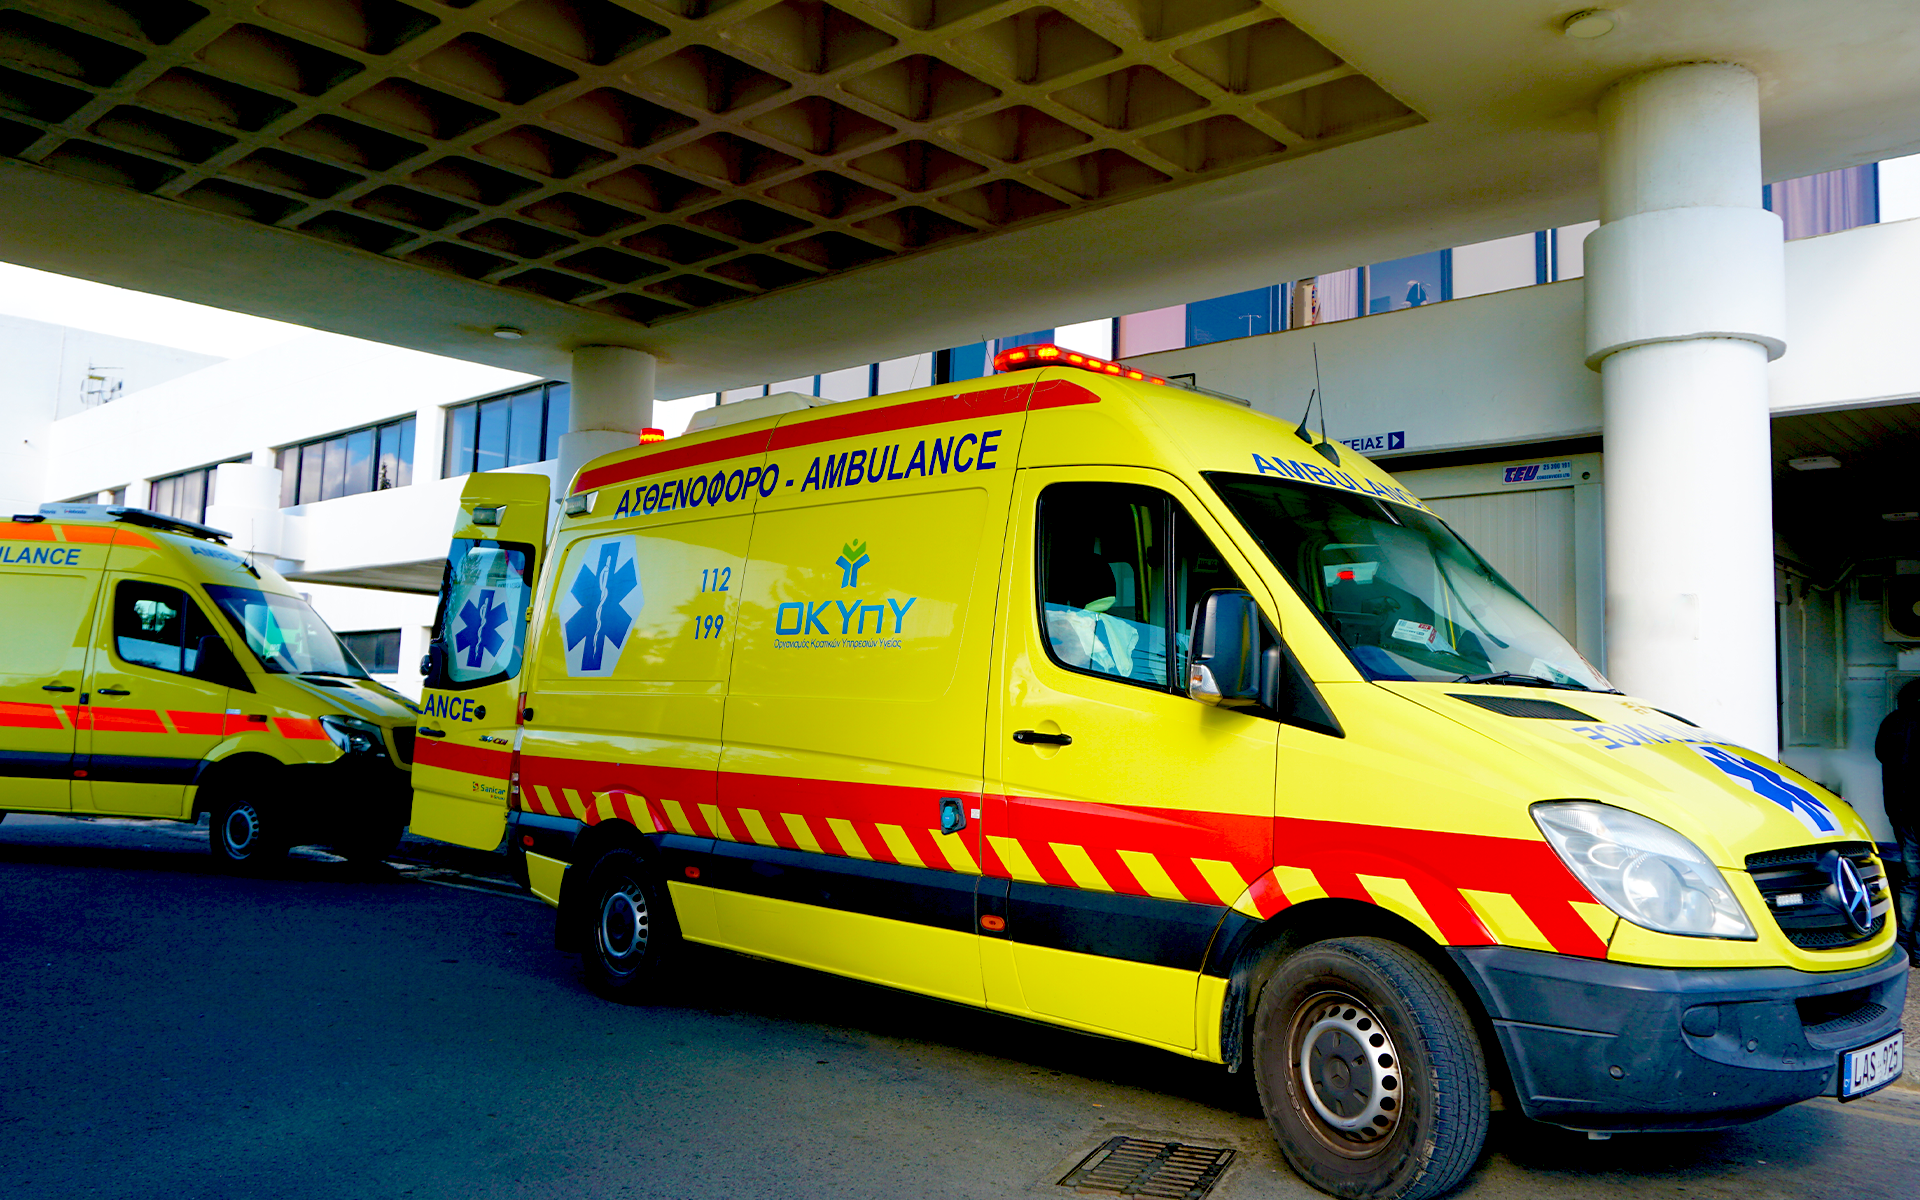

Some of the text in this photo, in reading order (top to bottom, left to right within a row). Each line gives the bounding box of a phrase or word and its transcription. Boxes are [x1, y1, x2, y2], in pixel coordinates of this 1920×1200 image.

[613, 463, 779, 520] ΑΣΘΕΝΟΦΟΡΟ
[800, 429, 1002, 492] AMBULANCE
[701, 566, 732, 593] 112
[694, 614, 724, 640] 199
[480, 784, 505, 796] Sanicar
[1854, 1040, 1898, 1088] LAS 925
